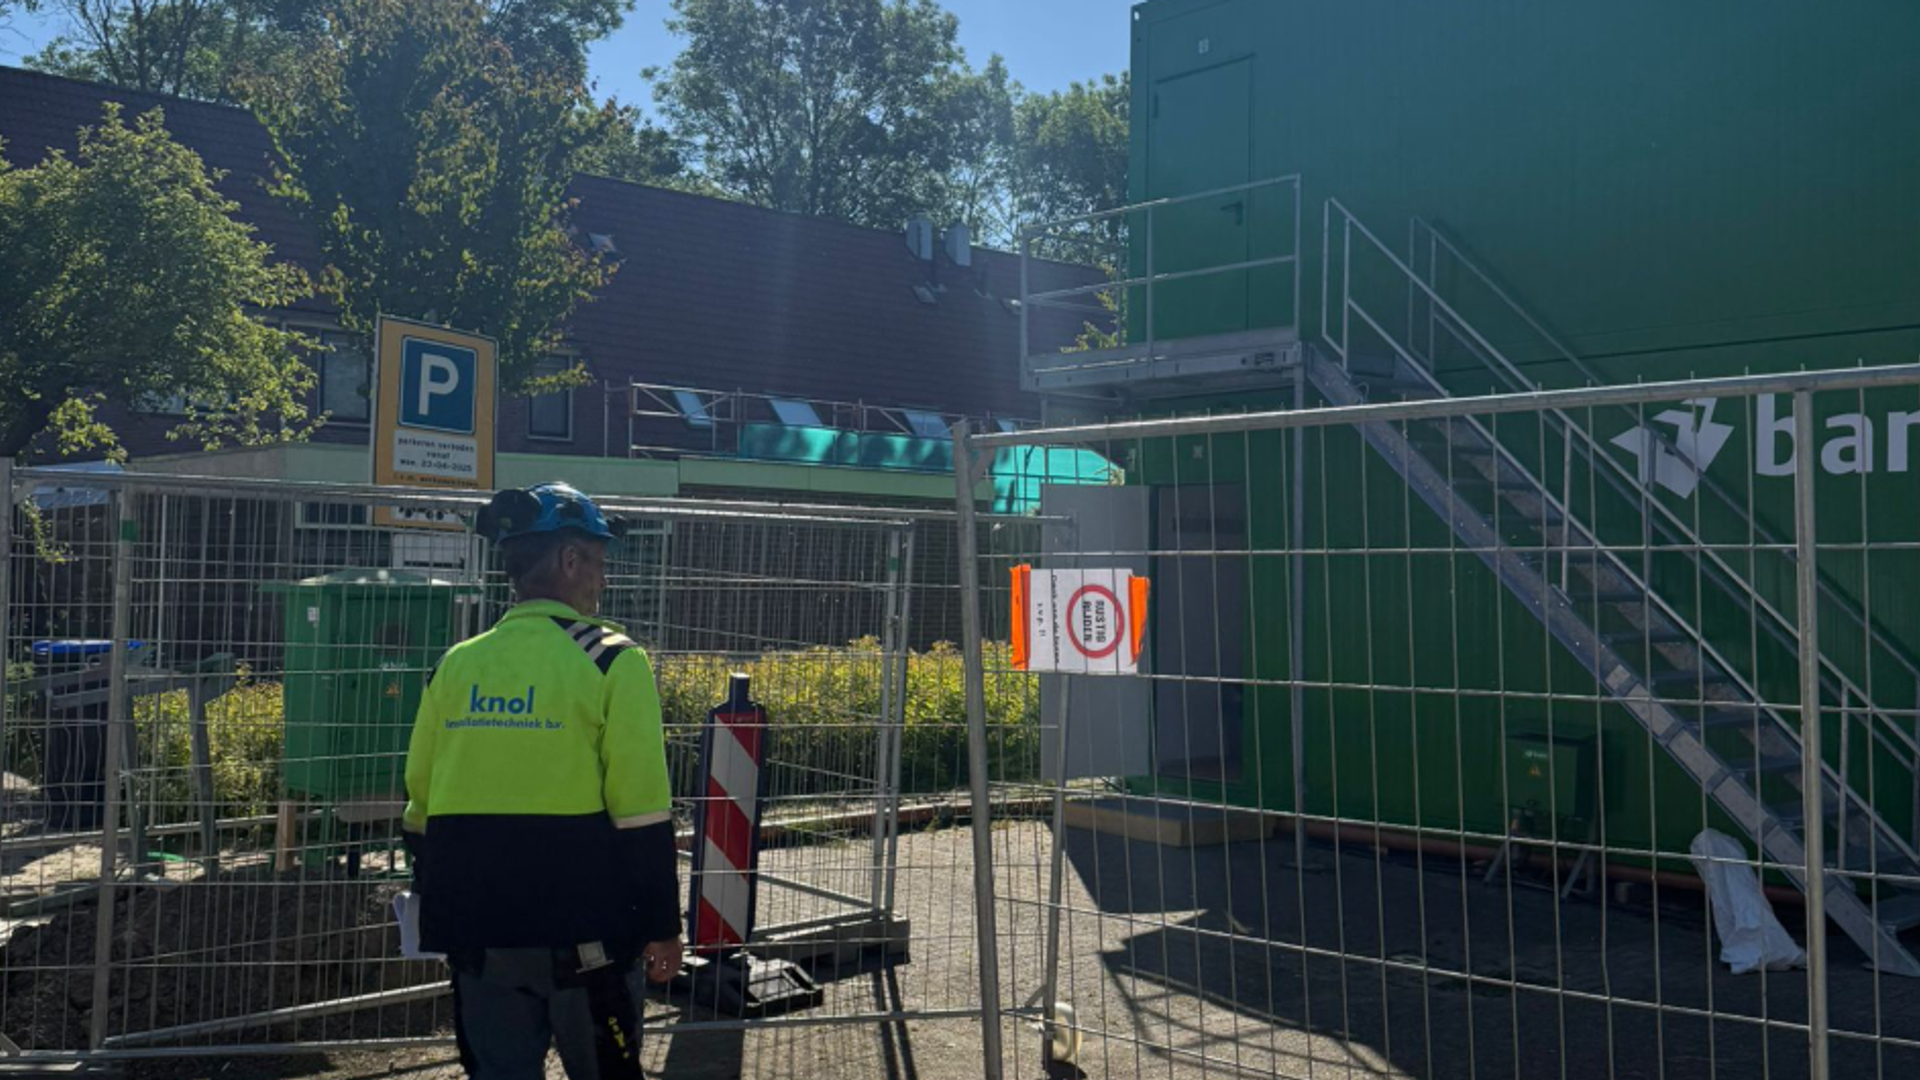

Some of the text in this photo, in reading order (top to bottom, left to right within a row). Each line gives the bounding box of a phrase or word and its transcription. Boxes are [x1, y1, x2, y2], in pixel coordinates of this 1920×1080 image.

[418, 353, 458, 415] P
[1082, 600, 1093, 643] RIJDEN
[1095, 599, 1107, 643] RUSTIG
[470, 684, 535, 714] knol
